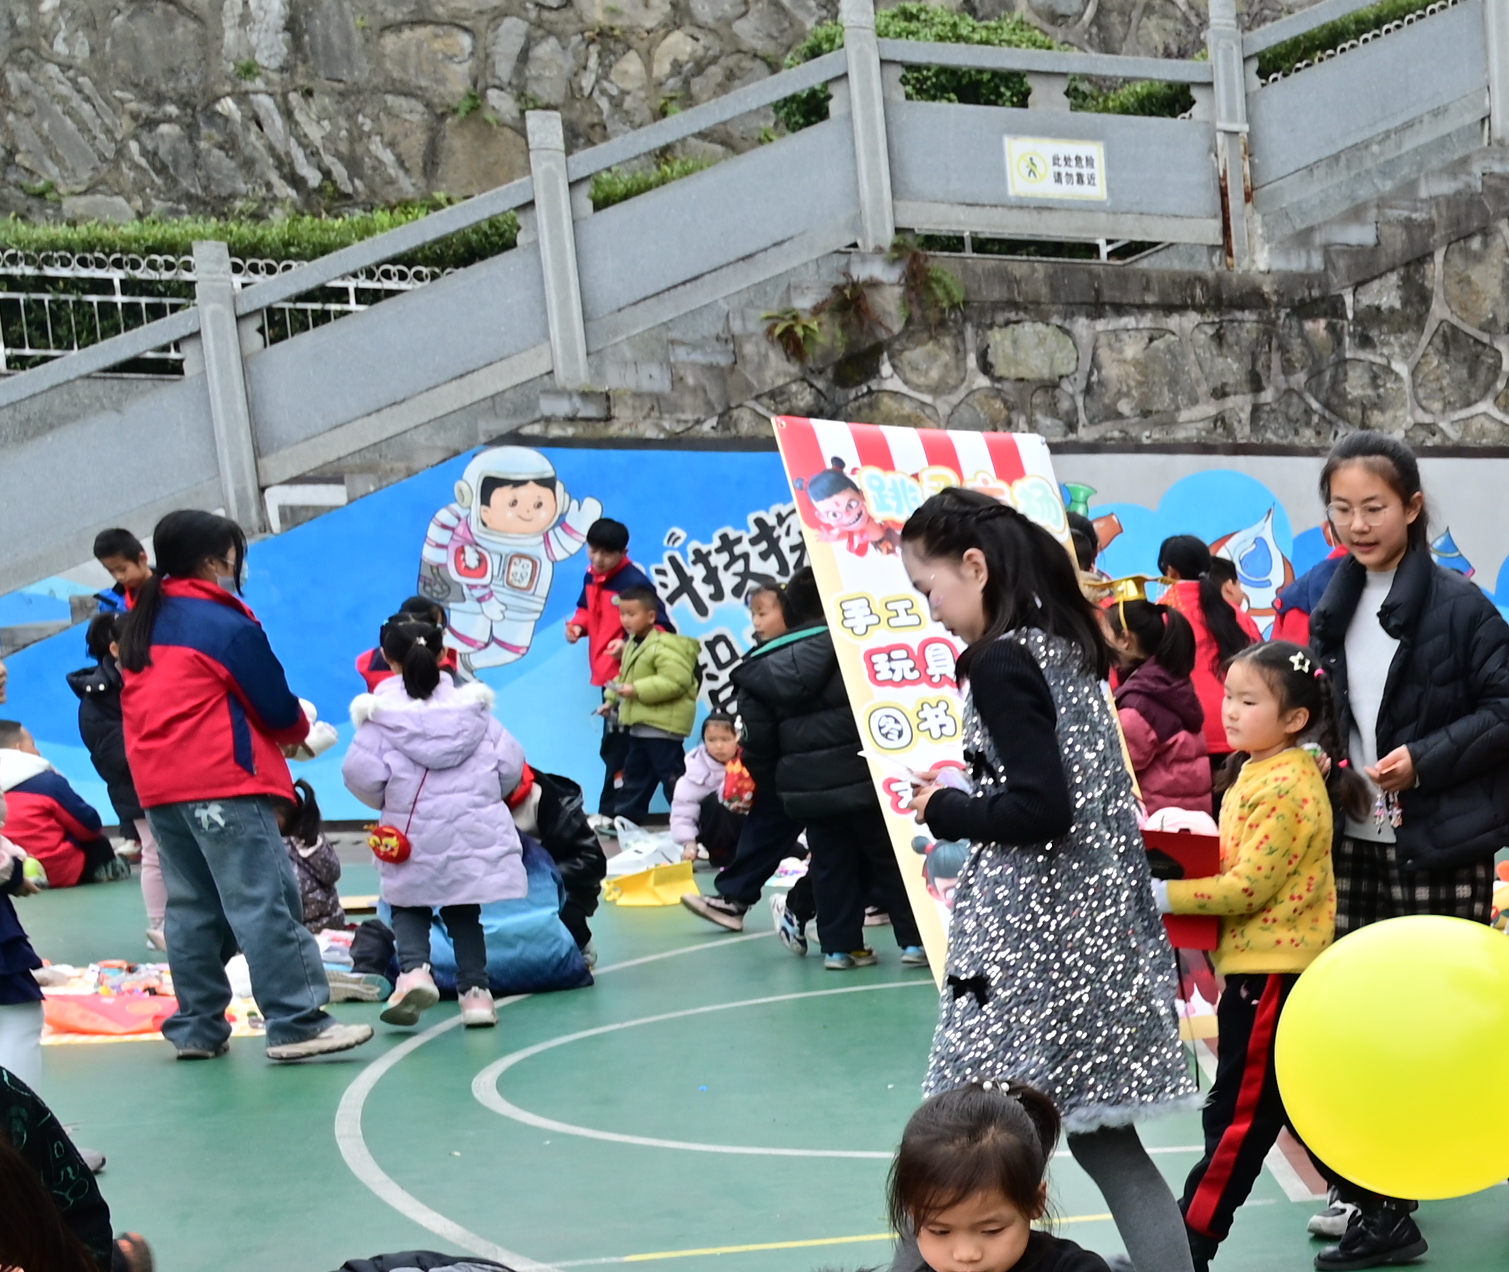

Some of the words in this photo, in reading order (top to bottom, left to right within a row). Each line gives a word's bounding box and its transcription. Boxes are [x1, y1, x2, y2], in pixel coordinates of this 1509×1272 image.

[1052, 153, 1095, 169] 此处危险
[1053, 171, 1097, 187] 请勿靠近
[840, 597, 921, 635] 手工
[871, 644, 957, 683] 玩具
[868, 701, 957, 749] 图书
